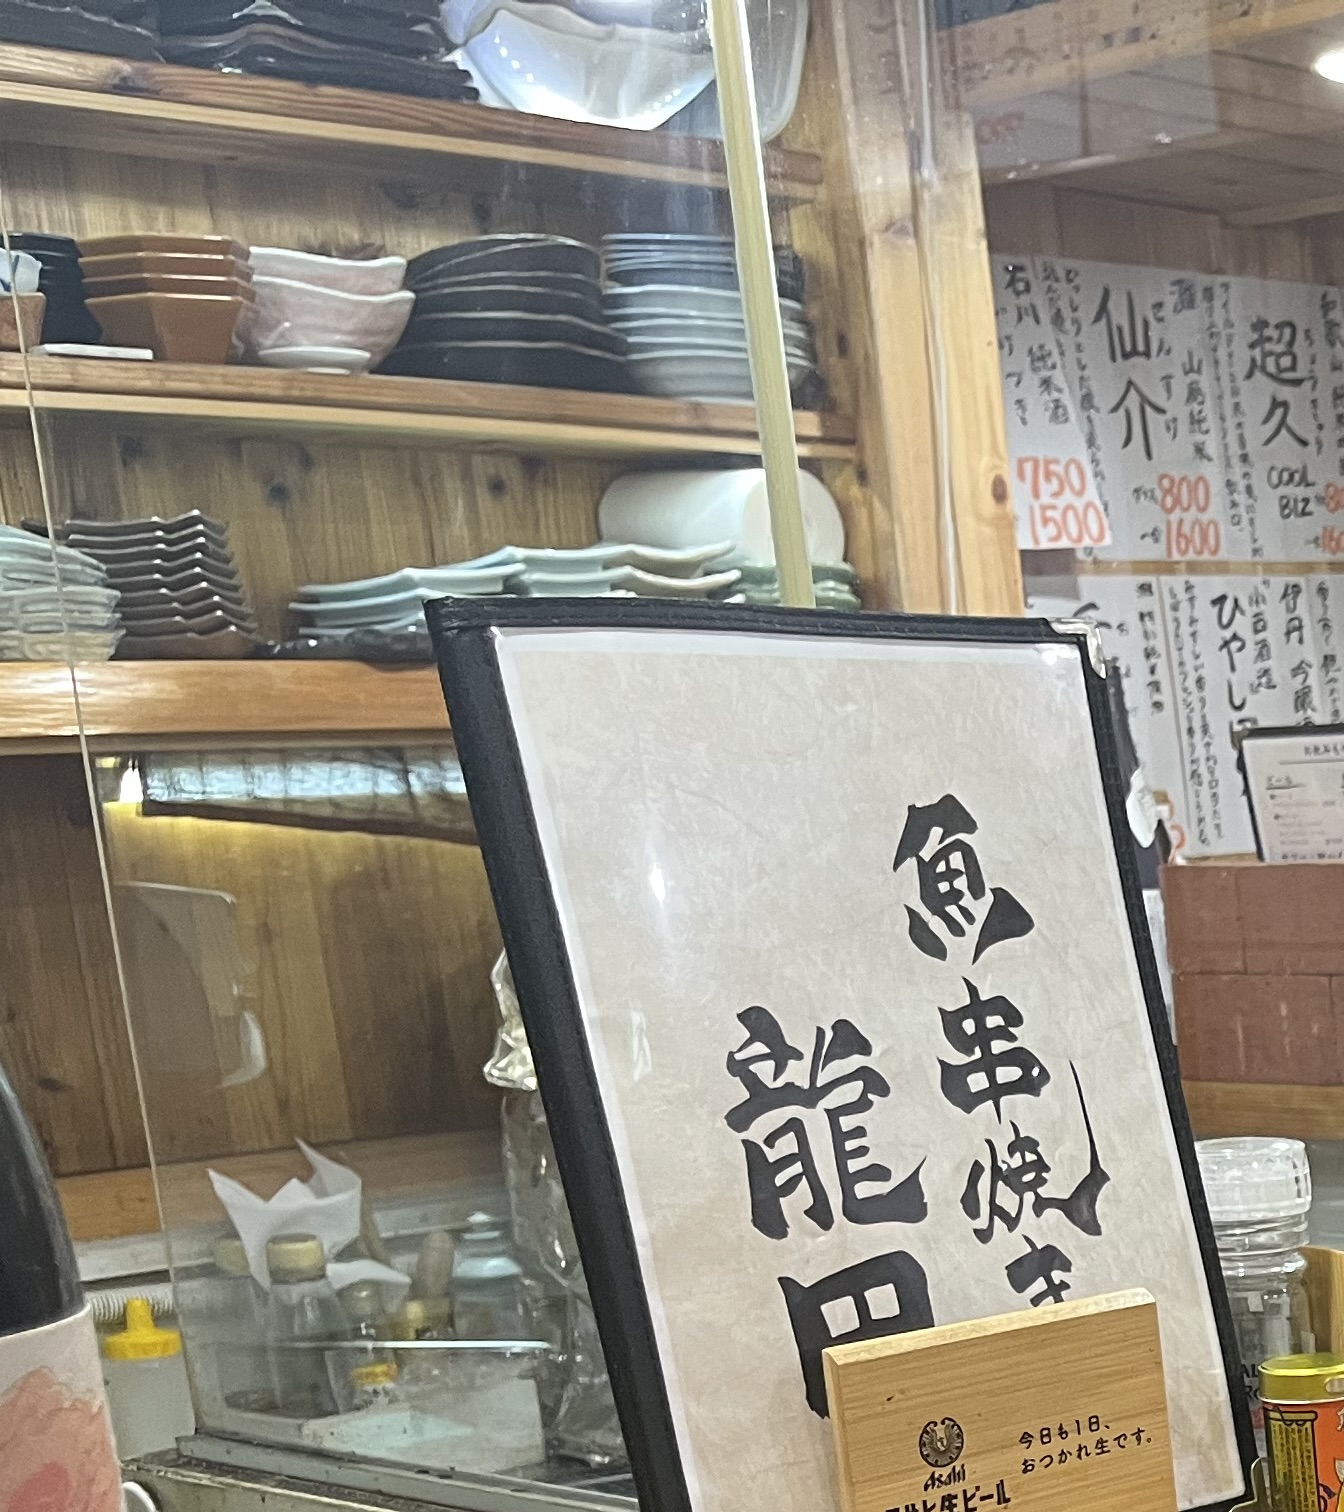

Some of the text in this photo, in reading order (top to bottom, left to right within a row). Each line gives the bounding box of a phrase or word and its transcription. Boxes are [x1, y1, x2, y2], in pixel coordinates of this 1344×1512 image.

[1091, 285, 1168, 462] 仙介
[1242, 316, 1310, 447] 超久
[1016, 455, 1087, 500] 750
[1156, 472, 1211, 515] 800
[1266, 464, 1316, 489] COOL
[1028, 500, 1107, 547] 1500
[1165, 517, 1222, 559] 1600
[1021, 1426, 1152, 1474] おつかれ生です。
[923, 1463, 967, 1492] Asahi
